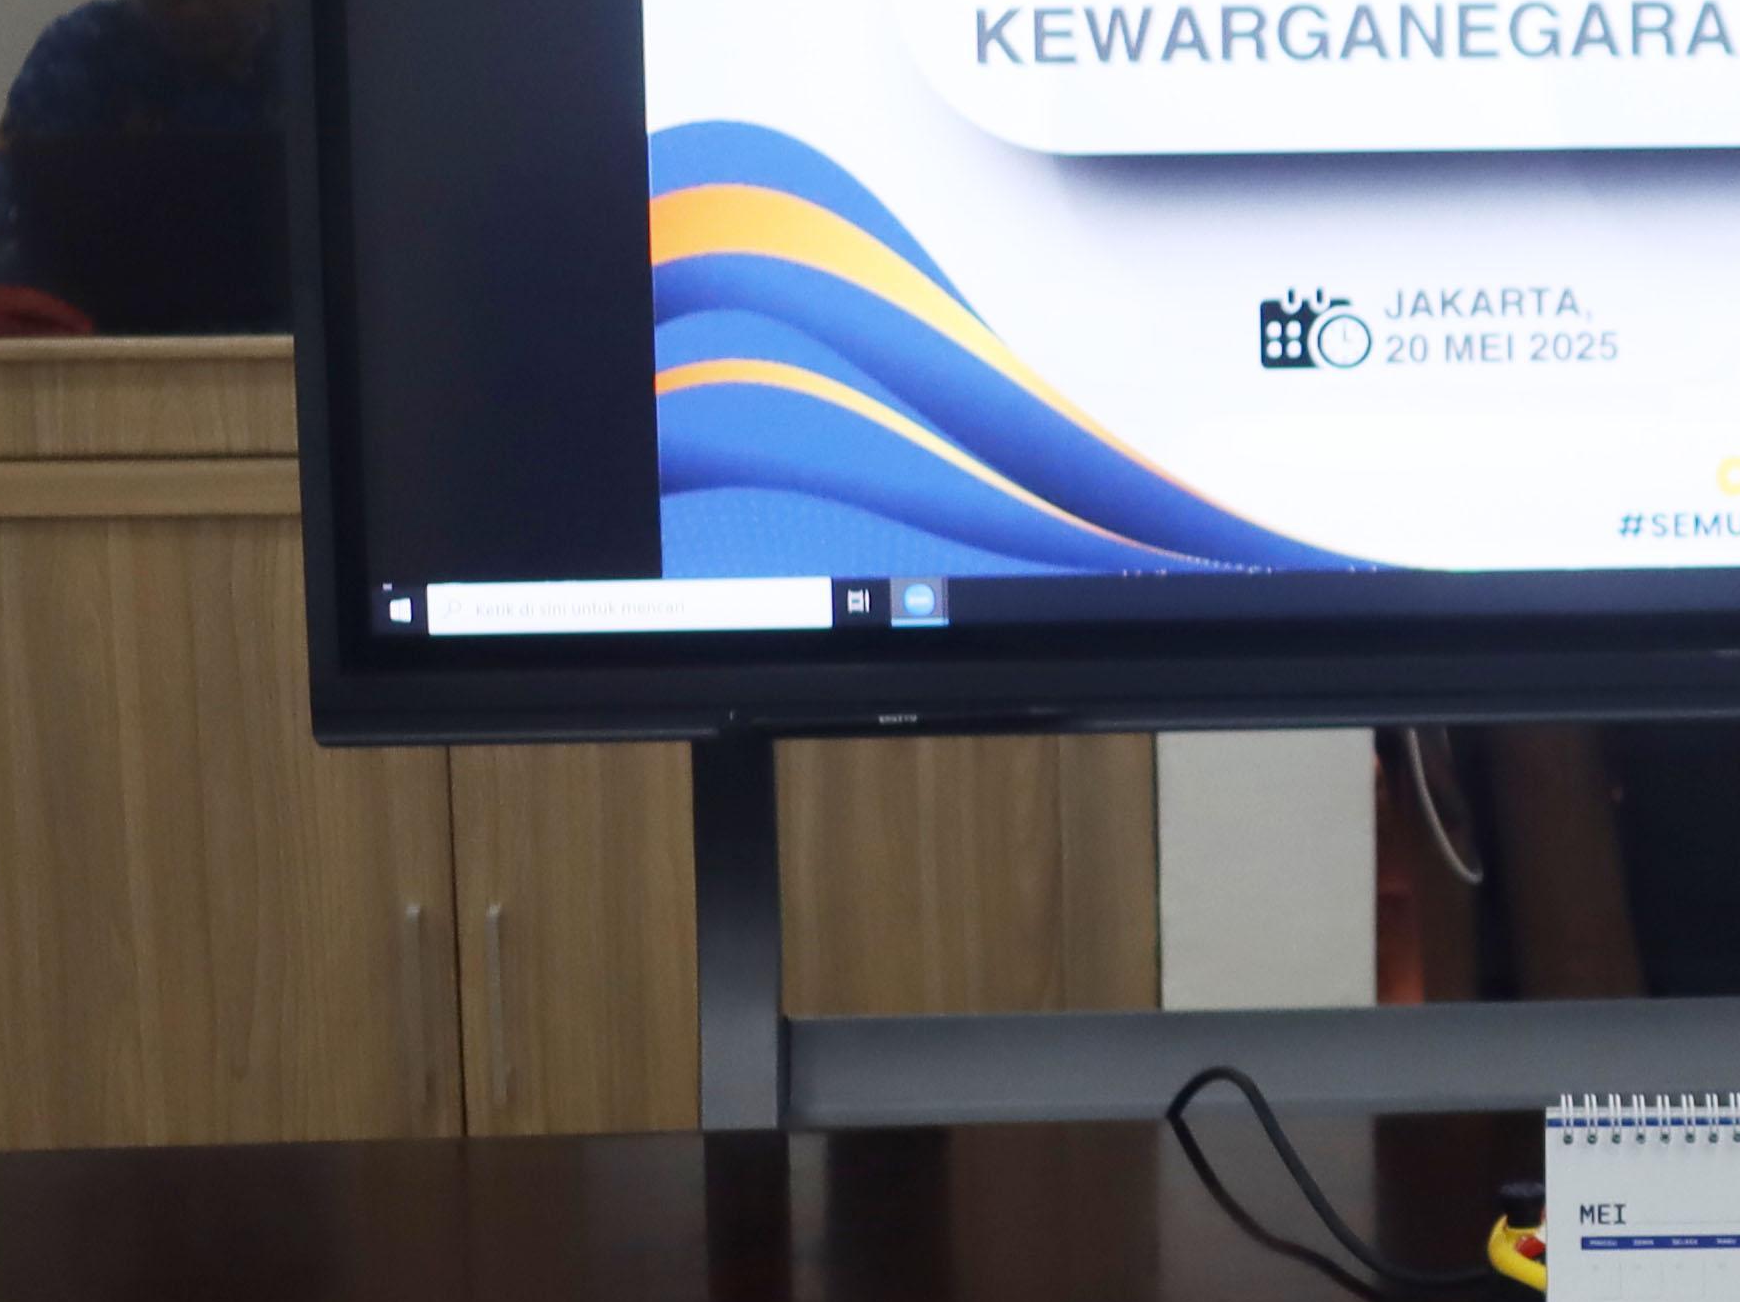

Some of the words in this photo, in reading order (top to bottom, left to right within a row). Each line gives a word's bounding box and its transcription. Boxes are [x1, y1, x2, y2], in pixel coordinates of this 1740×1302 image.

[1384, 287, 1595, 323] JAKARTA,
[1385, 332, 1432, 366] 20
[1444, 331, 1517, 365] MEI
[1529, 330, 1622, 364] 2025
[572, 601, 617, 616] untuk
[621, 601, 685, 615] mencari
[1579, 1204, 1627, 1226] MEI
